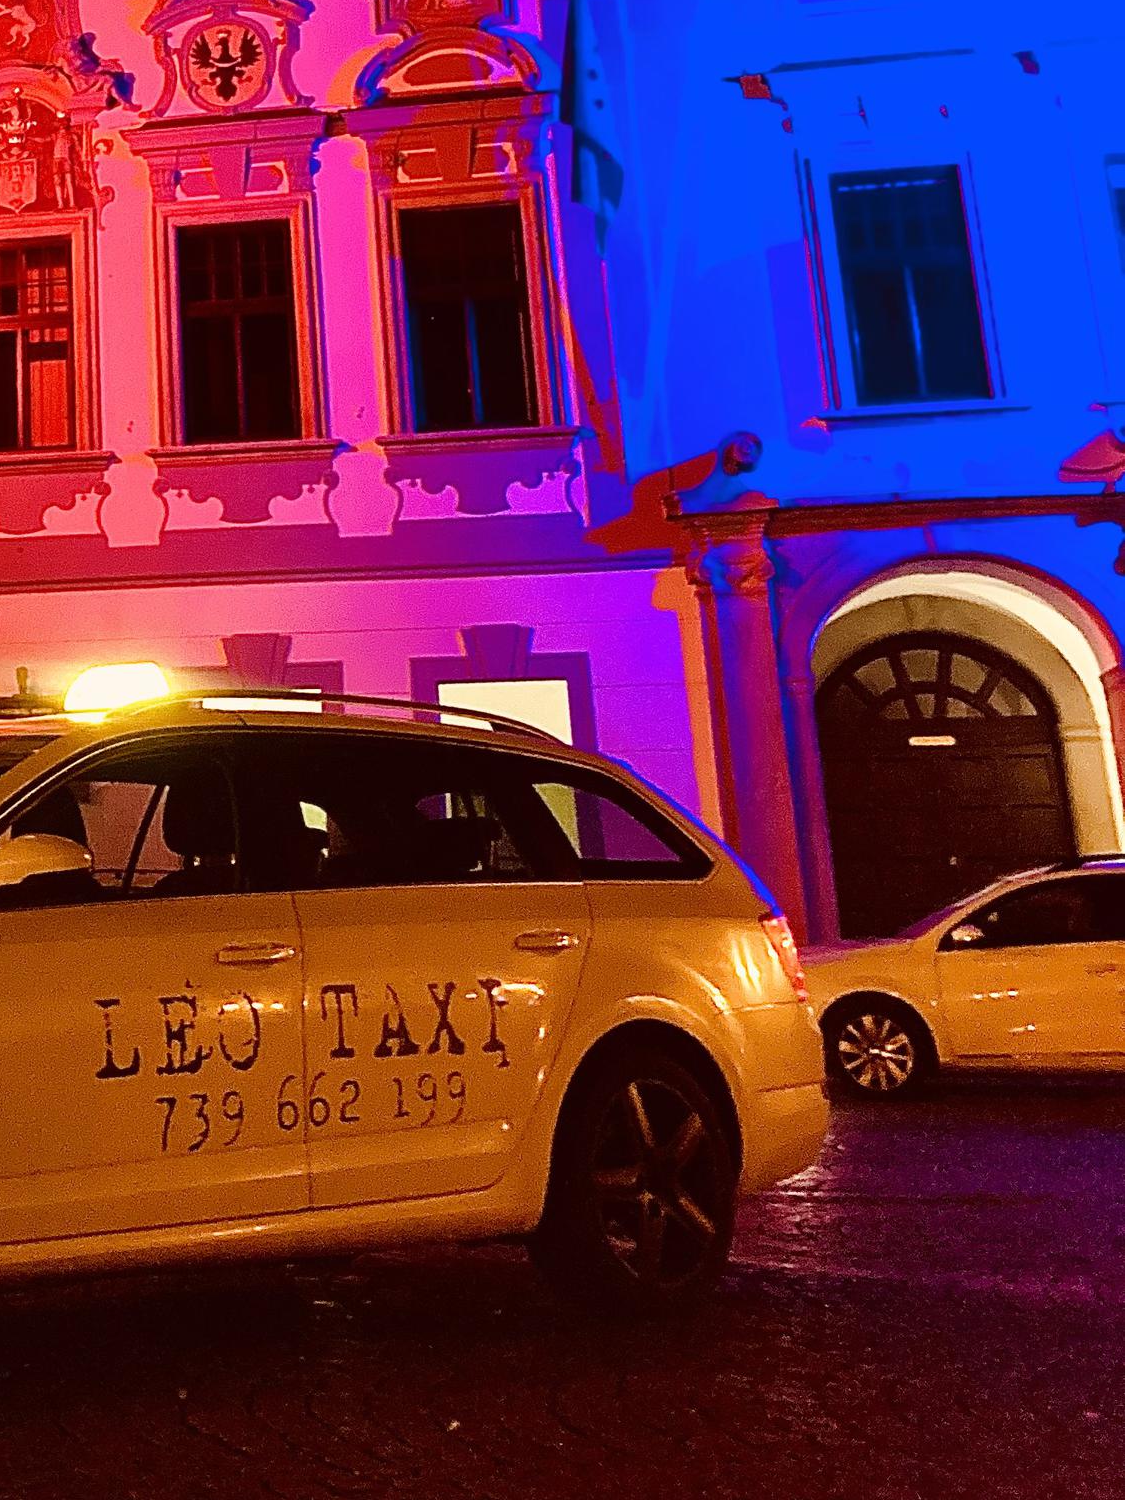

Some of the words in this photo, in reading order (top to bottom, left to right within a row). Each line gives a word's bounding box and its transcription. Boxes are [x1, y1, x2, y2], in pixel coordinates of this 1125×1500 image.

[321, 978, 510, 1068] TAXI
[155, 1090, 243, 1151] 739
[277, 1071, 361, 1131] 662
[392, 1070, 466, 1127] 199
